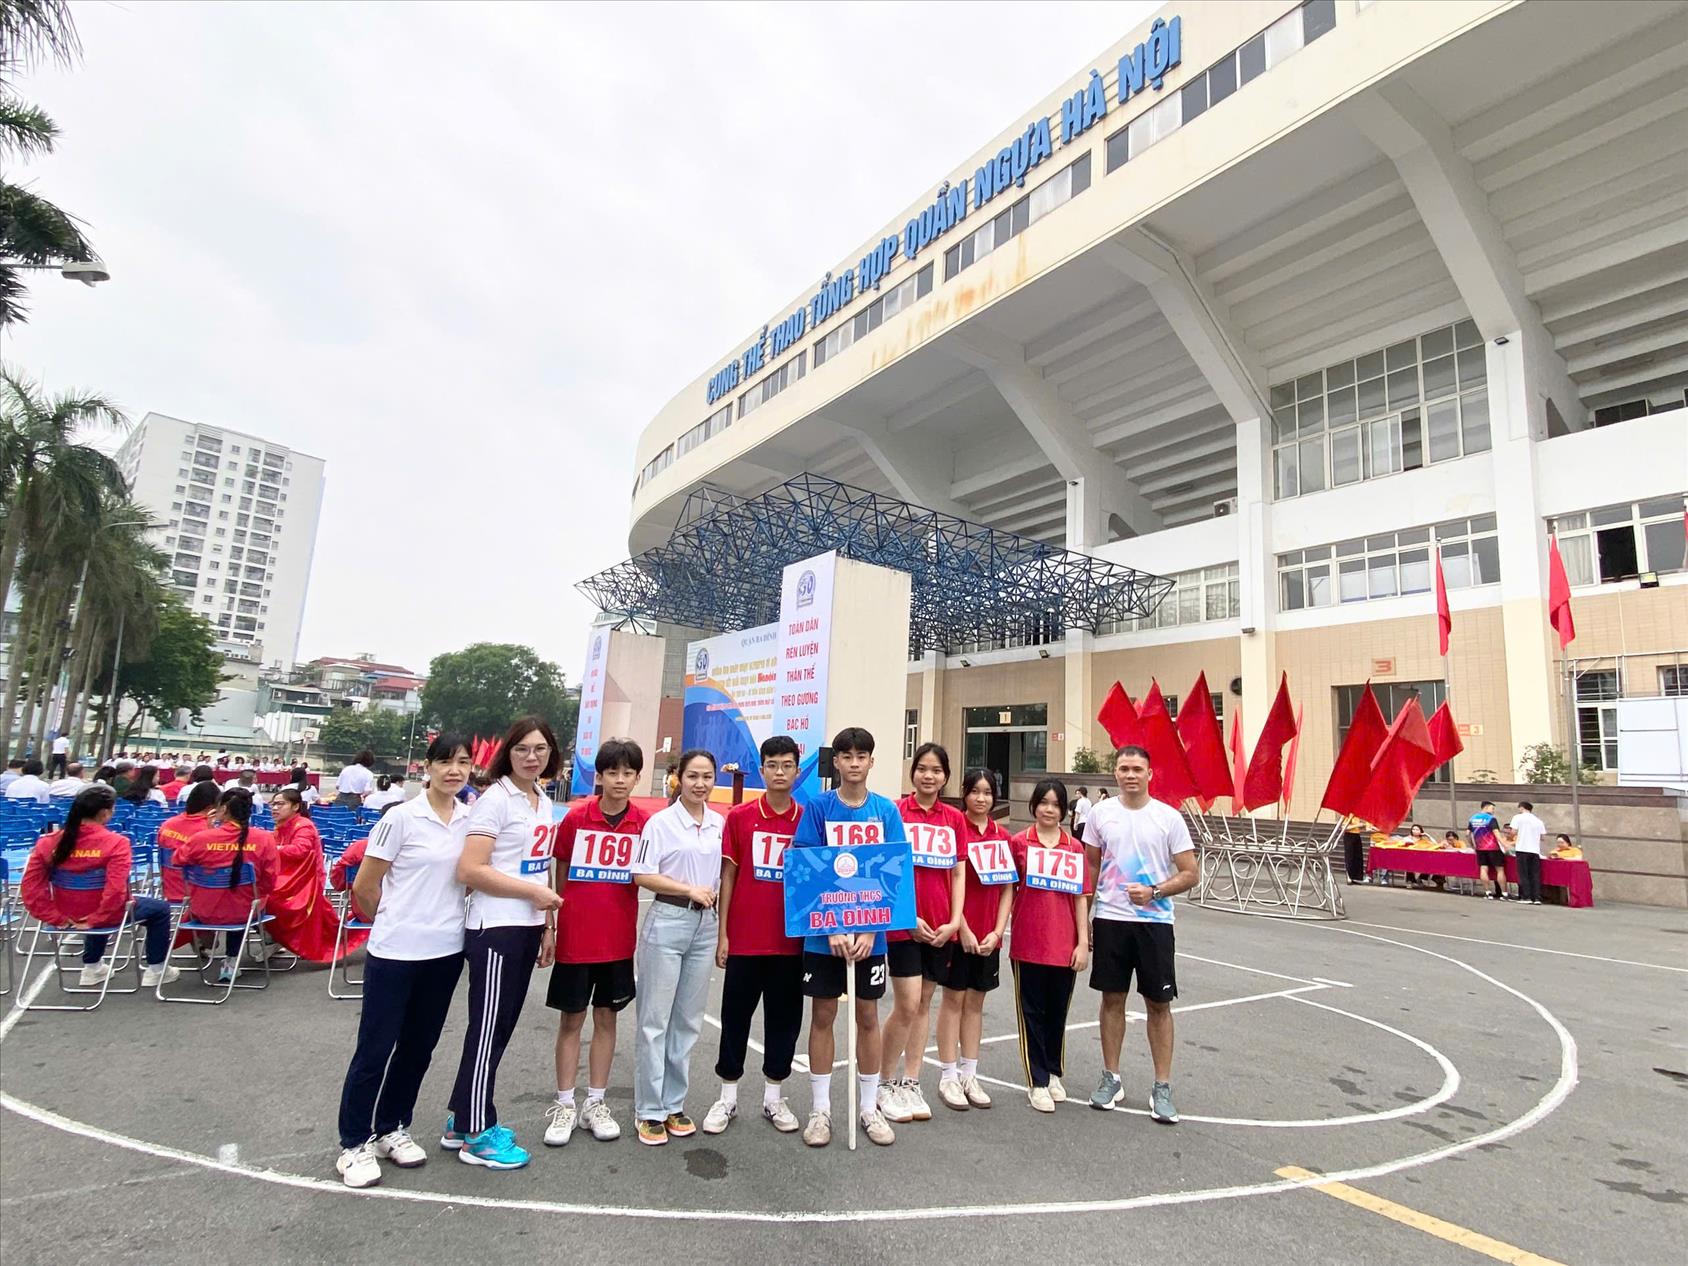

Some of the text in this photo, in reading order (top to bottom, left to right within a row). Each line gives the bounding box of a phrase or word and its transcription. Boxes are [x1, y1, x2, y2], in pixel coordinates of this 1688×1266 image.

[706, 359, 740, 405] CUNG
[742, 324, 768, 381] THỂ
[769, 306, 806, 360] THAO
[809, 271, 855, 330] TỔNG
[857, 234, 900, 291] HỢP
[974, 116, 1053, 209] NGỰA
[1061, 68, 1107, 145] HÀ
[1118, 15, 1182, 105] NỘI
[1375, 660, 1393, 673] 3
[781, 694, 796, 707] THEO
[530, 823, 559, 857] 21
[833, 824, 880, 845] 168
[909, 825, 952, 855] 173
[584, 834, 633, 868] 169
[761, 836, 791, 867] 17
[971, 843, 1008, 870] 174
[527, 861, 542, 873] BA
[575, 869, 630, 881] BA ĐÌNH
[755, 869, 772, 879] BA
[1035, 850, 1078, 880] 175
[860, 890, 881, 901] THCS
[1031, 877, 1078, 892] BA ĐÌNH
[810, 906, 891, 928] BA ĐÌNH
[870, 963, 885, 986] 23
